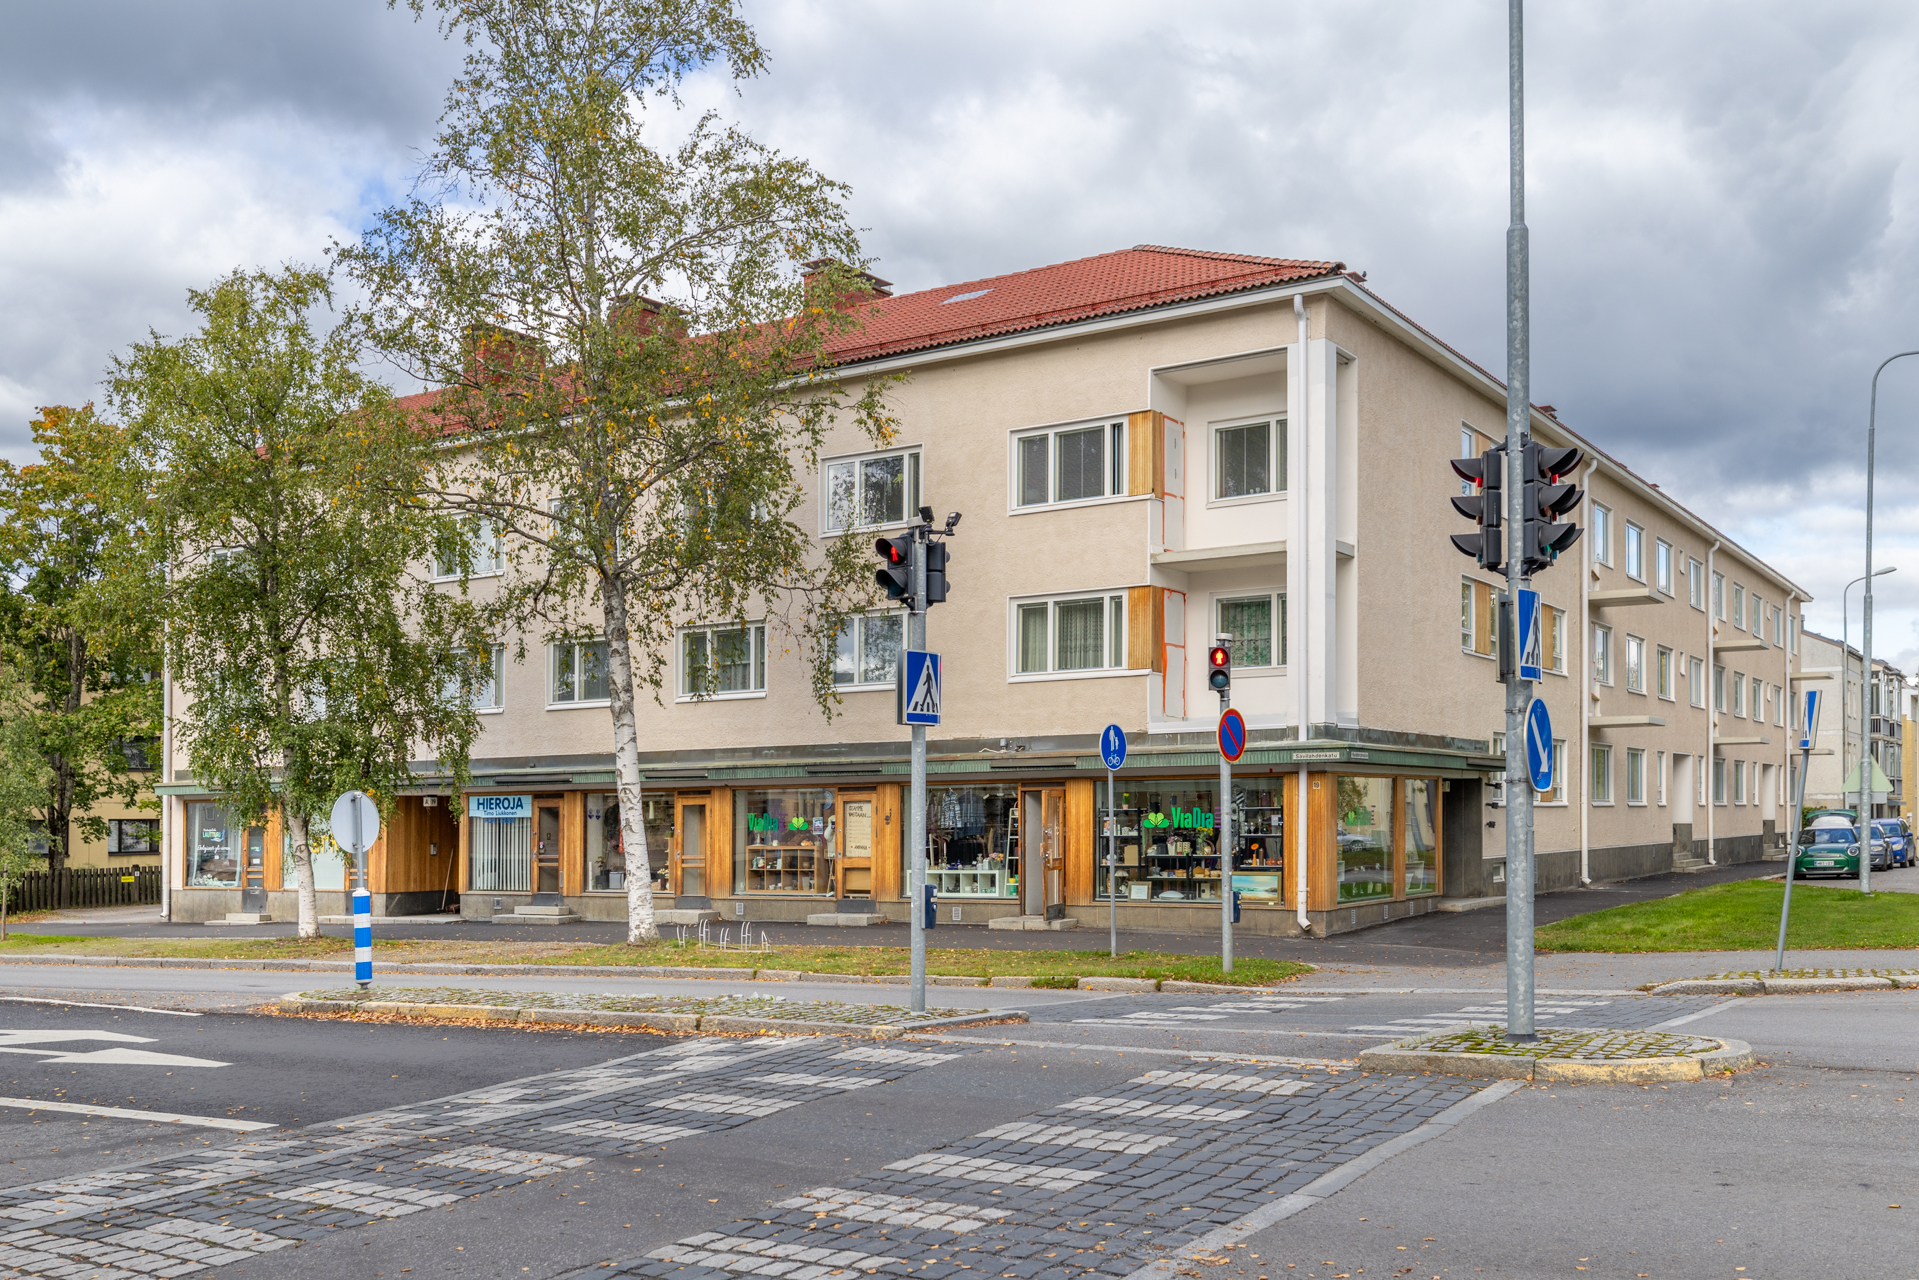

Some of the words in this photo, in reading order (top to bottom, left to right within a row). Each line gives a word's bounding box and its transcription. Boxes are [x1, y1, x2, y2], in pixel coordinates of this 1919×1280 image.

[477, 796, 524, 811] HIEROJA
[748, 812, 779, 831] ViaDia
[1171, 806, 1214, 829] ViaDia
